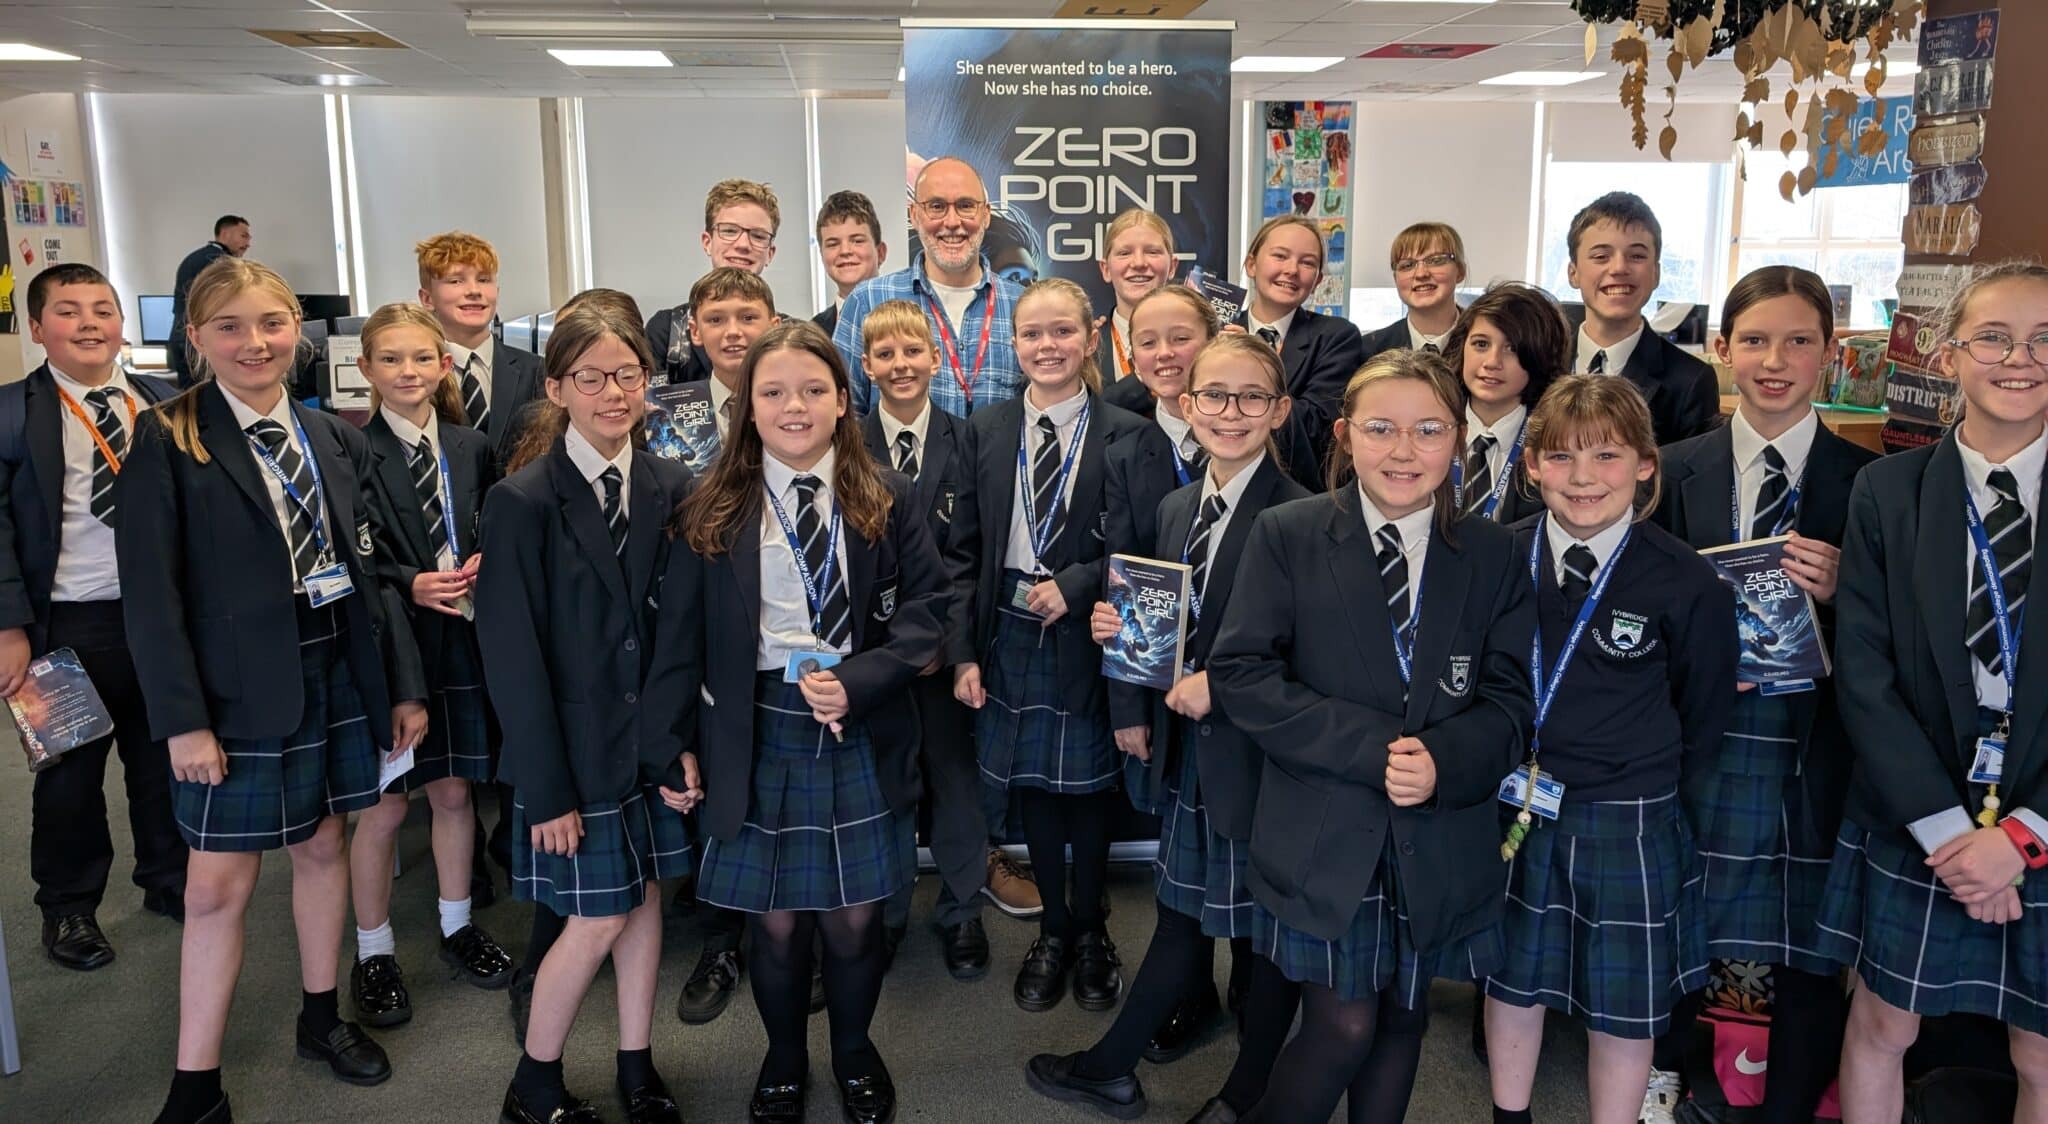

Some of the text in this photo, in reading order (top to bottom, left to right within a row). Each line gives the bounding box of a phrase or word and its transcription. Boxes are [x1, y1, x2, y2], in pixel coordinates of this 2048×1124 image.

[956, 61, 1177, 75] She never wanted to be a hero.
[985, 81, 1152, 96] Now she has no choice.
[1014, 127, 1197, 167] ZERO
[1000, 175, 1197, 214] POINT
[1887, 382, 1947, 408] DISTRICT
[675, 401, 708, 412] ZERO
[673, 409, 709, 421] POINT
[683, 419, 712, 427] GIRL
[793, 546, 817, 601] COMPASSION
[1141, 586, 1176, 600] ZERO
[1744, 579, 1791, 594] POINT
[1138, 595, 1176, 608] POINT
[1759, 589, 1799, 602] GIRL
[1992, 590, 2003, 614] College
[1146, 606, 1174, 619] GIRL
[1612, 609, 1648, 622] IVYBRIDGE
[1996, 614, 2011, 650] Community
[1592, 628, 1625, 658] COMMUNITY
[1557, 643, 1574, 672] Community
[1548, 671, 1561, 692] College
